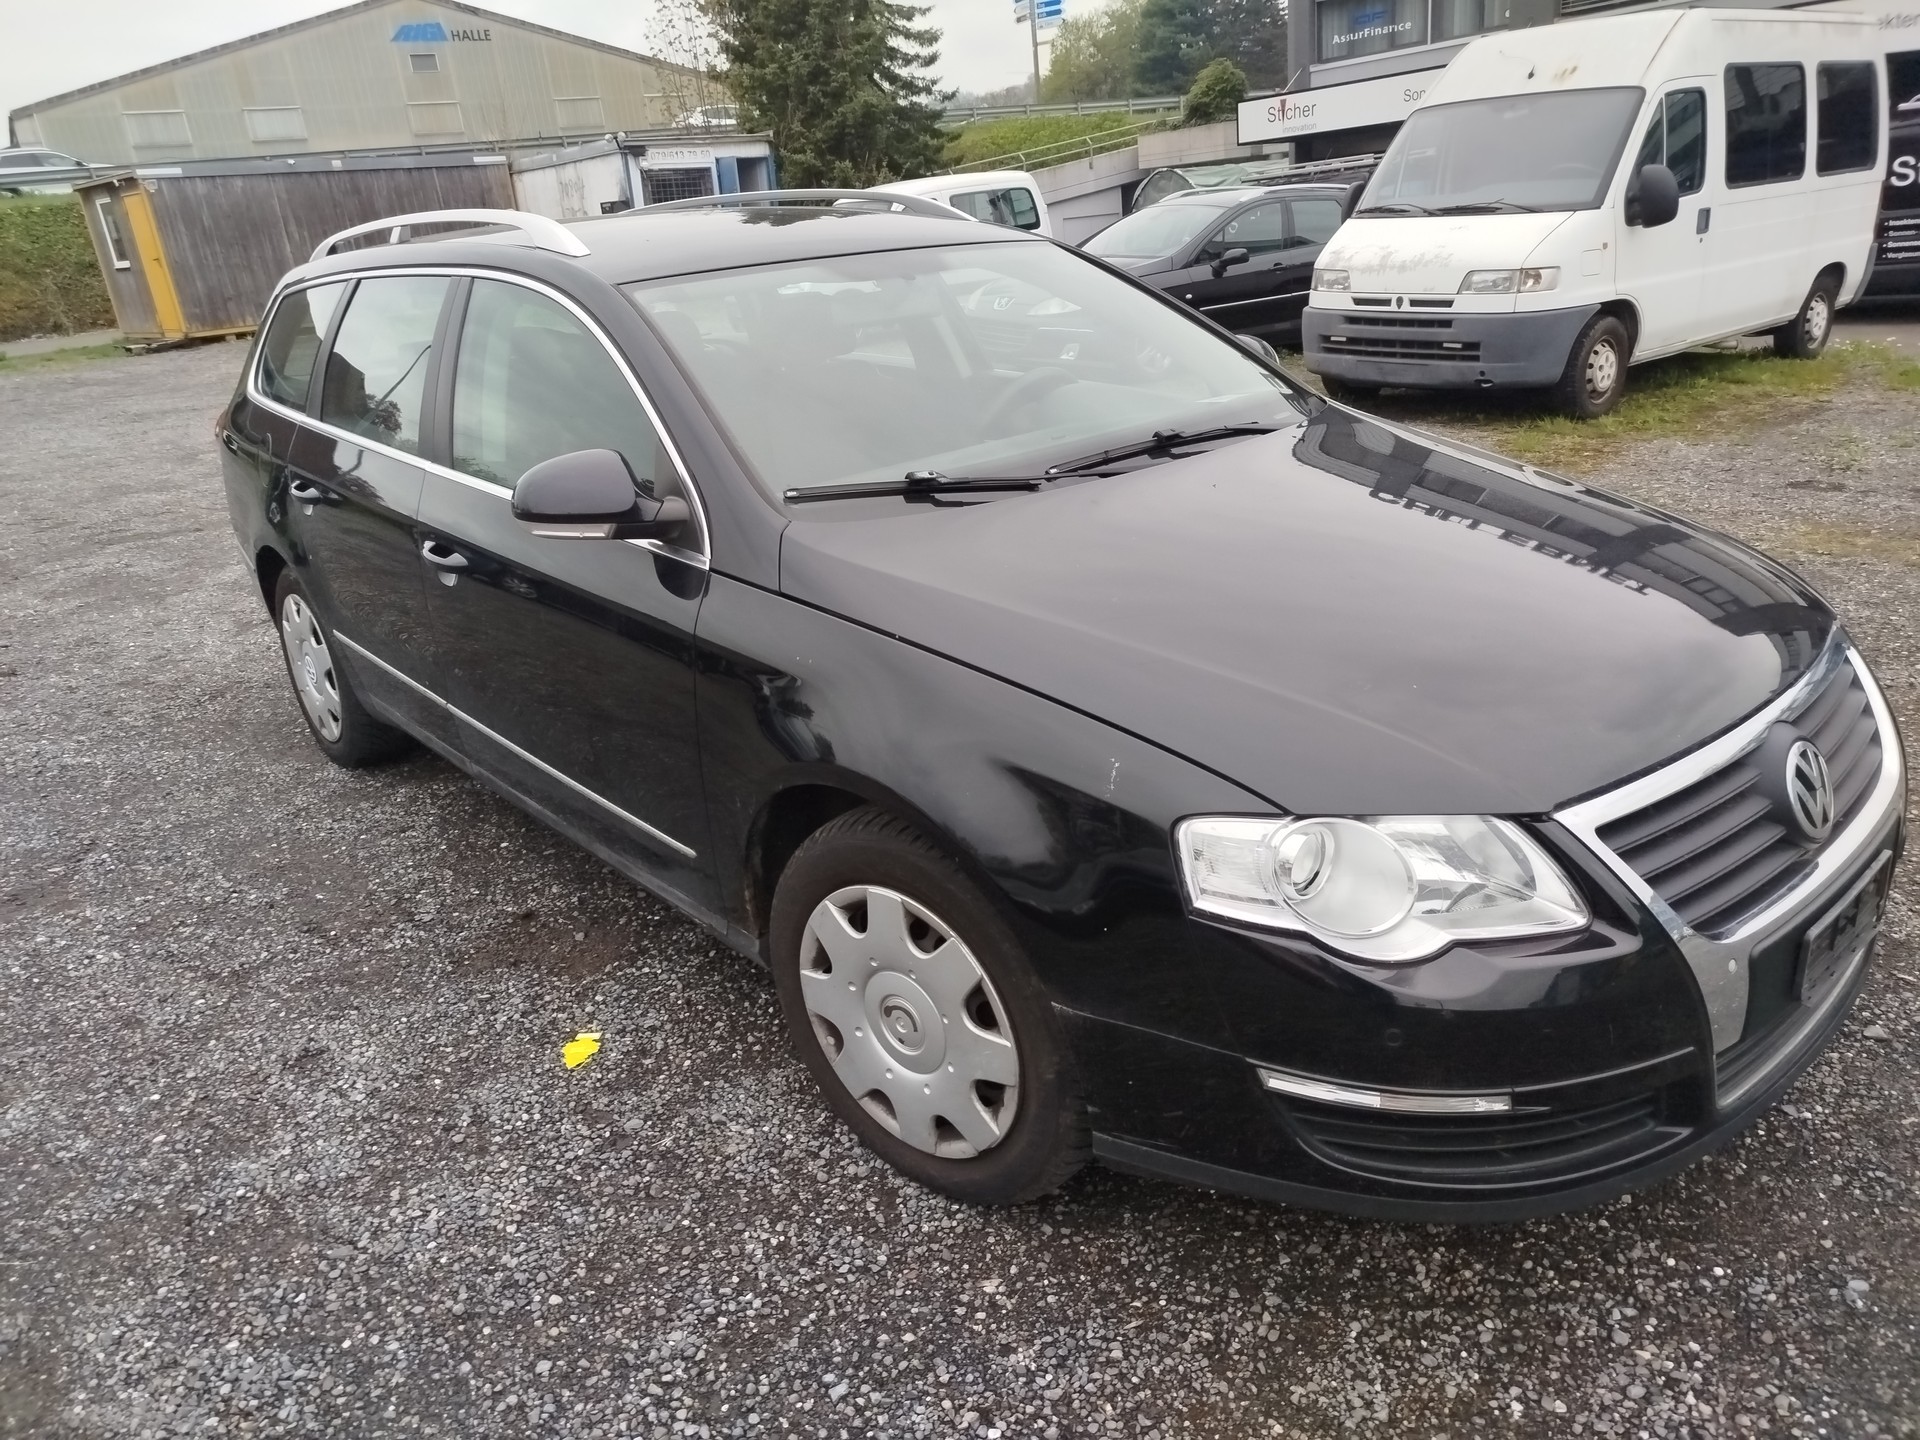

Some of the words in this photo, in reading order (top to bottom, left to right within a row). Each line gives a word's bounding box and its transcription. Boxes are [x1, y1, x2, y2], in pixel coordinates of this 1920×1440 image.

[450, 29, 492, 41] HALLE
[1332, 21, 1412, 44] AssurFinance
[1283, 122, 1317, 134] innovation
[1890, 155, 1920, 187] S
